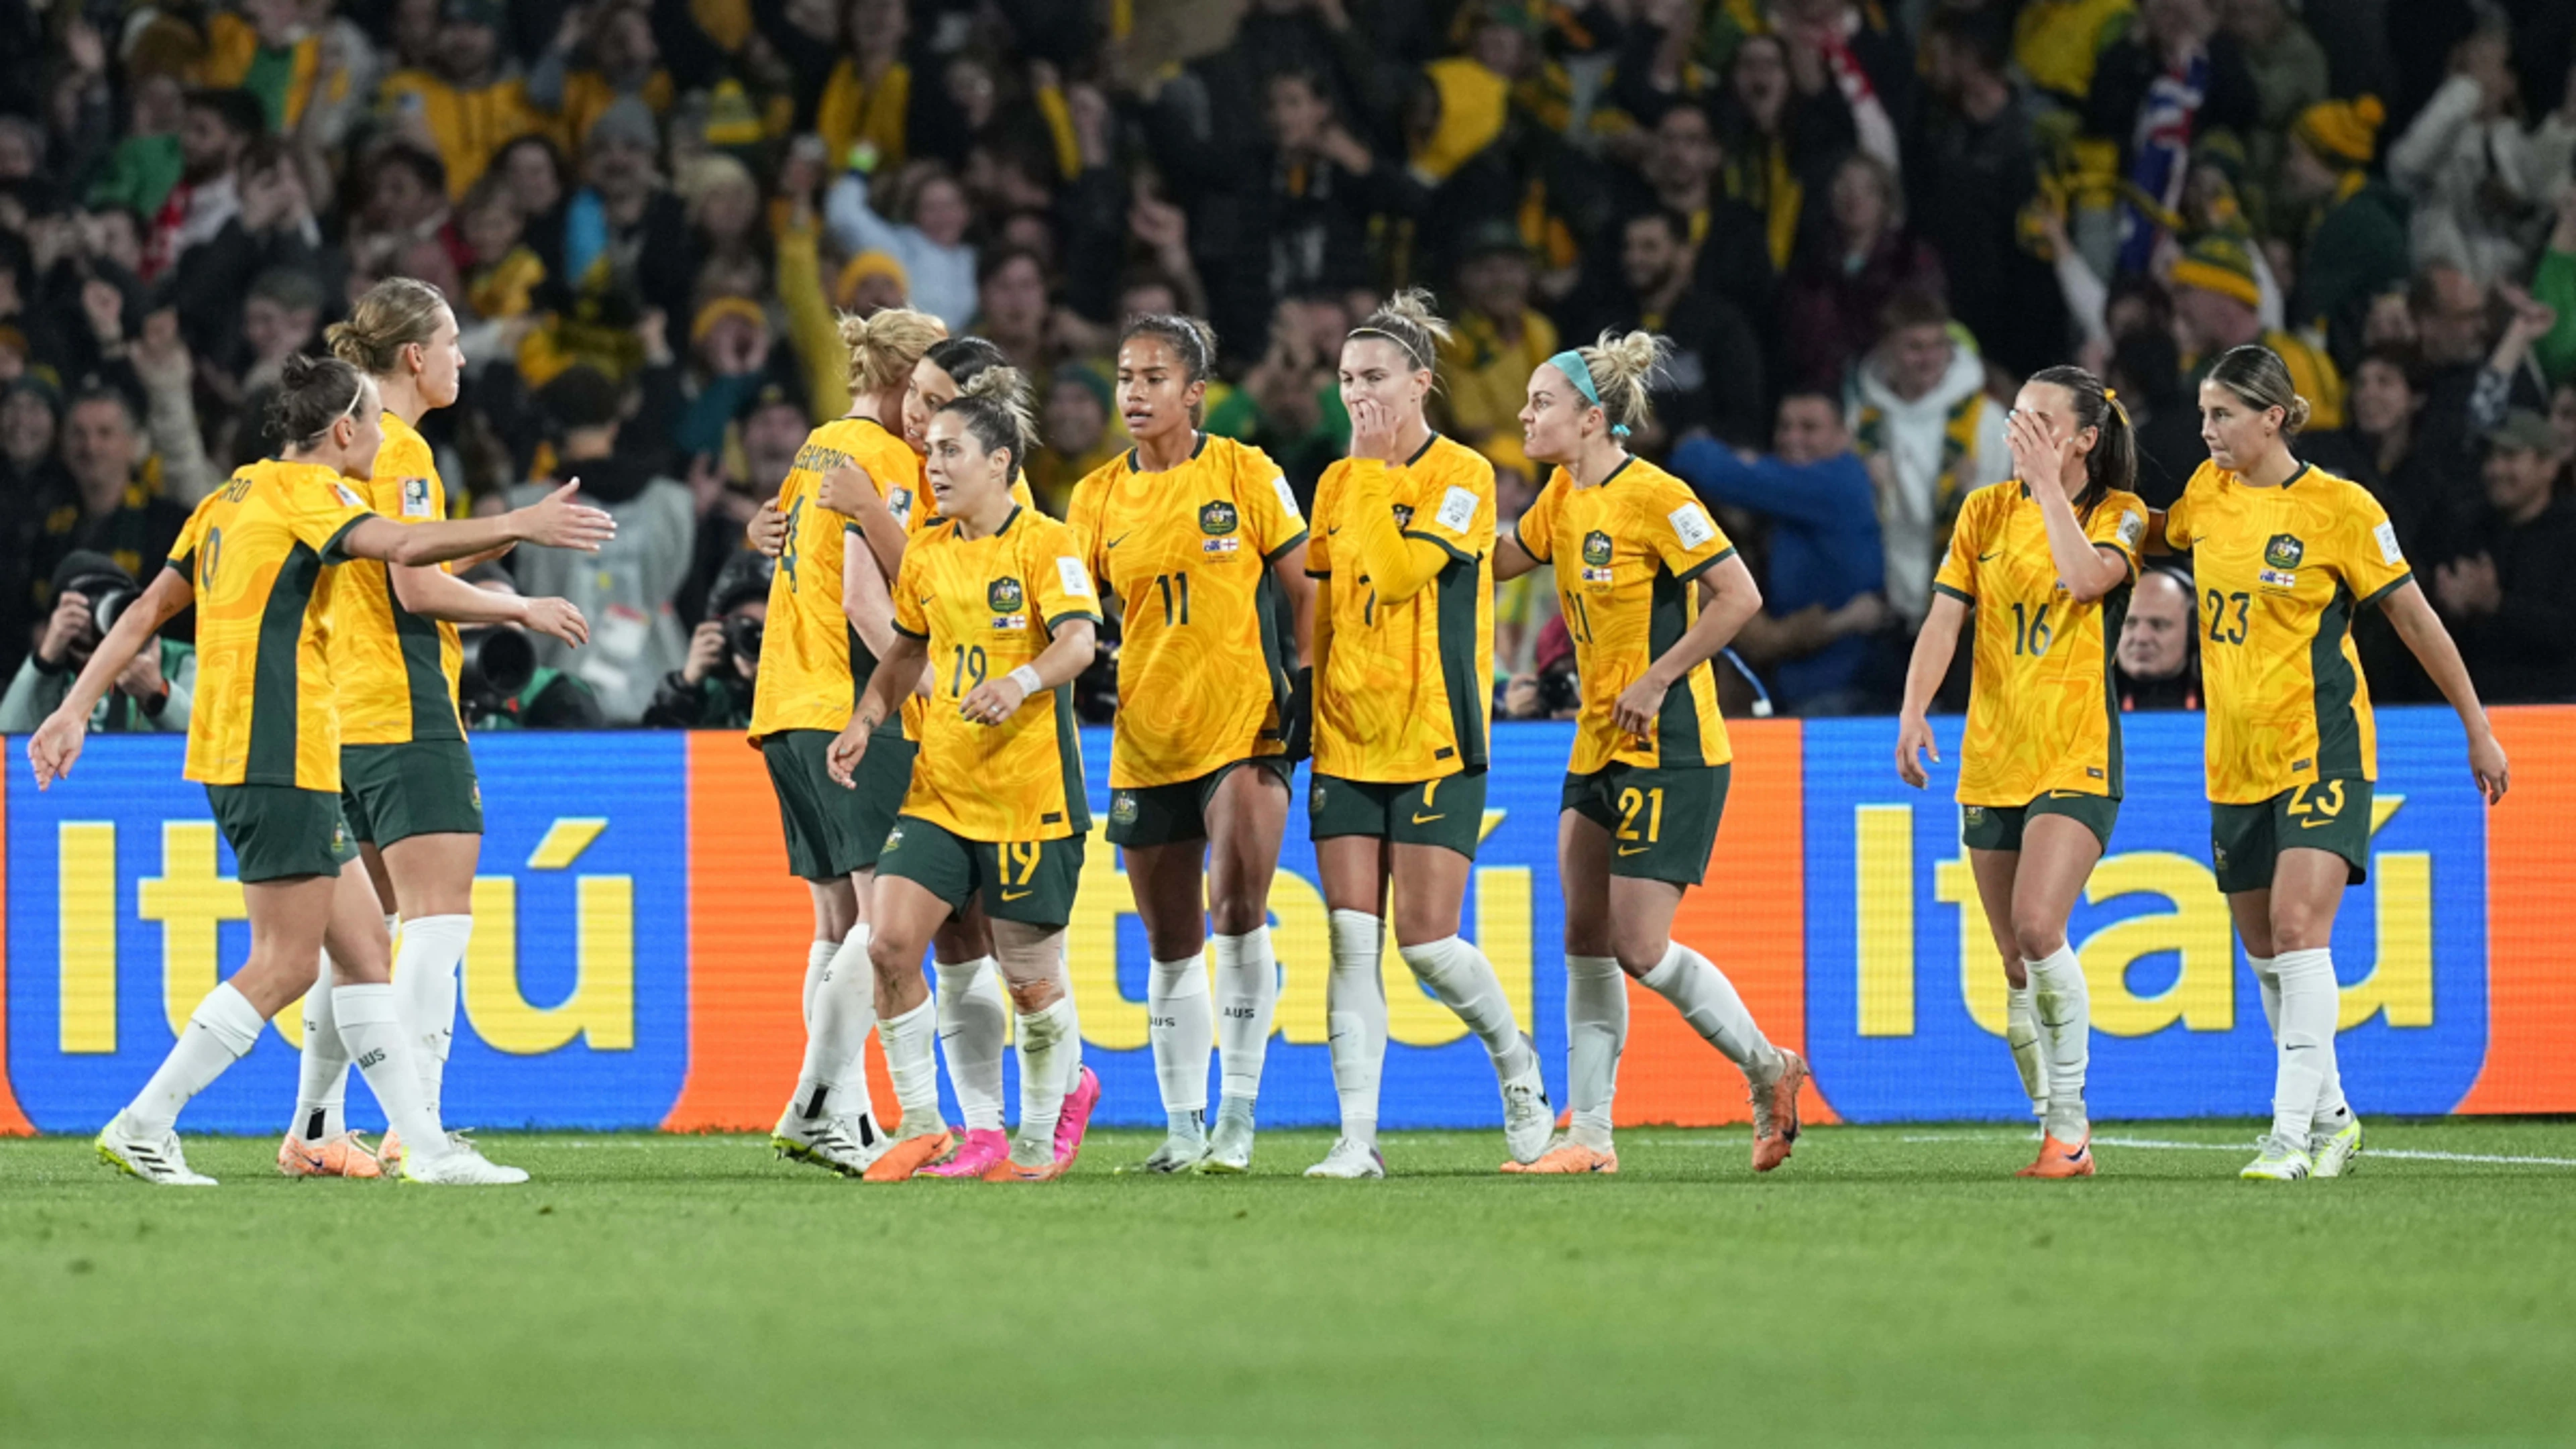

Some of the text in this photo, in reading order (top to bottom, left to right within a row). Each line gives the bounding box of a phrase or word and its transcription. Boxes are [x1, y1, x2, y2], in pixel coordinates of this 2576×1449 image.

[1156, 571, 1189, 627] 11
[1566, 590, 1593, 644] 21
[2207, 588, 2250, 645] 23
[2012, 602, 2052, 657] 16
[952, 643, 987, 698] 19
[1617, 787, 1664, 843] 21
[2288, 779, 2345, 816] 23
[998, 841, 1041, 885] 19
[58, 818, 634, 1054] Itú
[996, 808, 1533, 1051] taú
[1224, 1006, 1255, 1018] AUS
[358, 1047, 386, 1070] AUS
